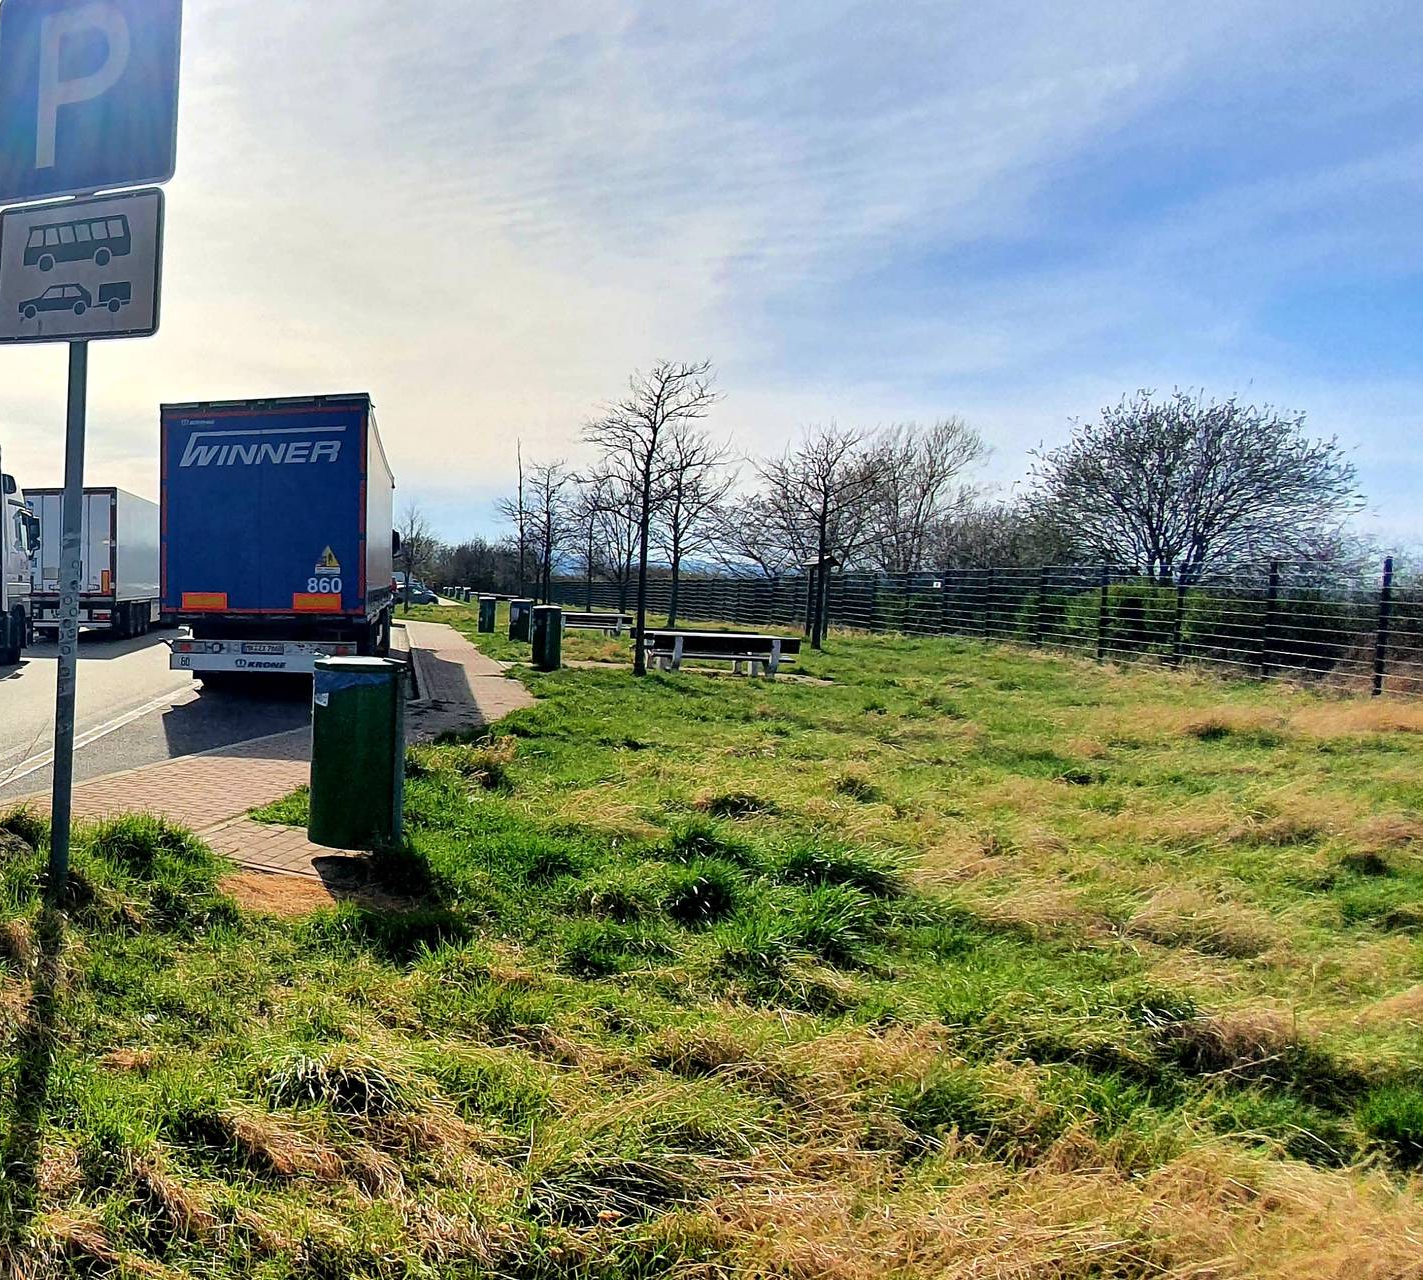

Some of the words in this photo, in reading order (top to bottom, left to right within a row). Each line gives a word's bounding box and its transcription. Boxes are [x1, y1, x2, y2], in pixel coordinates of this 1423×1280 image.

[36, 3, 129, 169] P
[179, 430, 345, 467] WINNER
[307, 577, 343, 593] 860
[180, 656, 190, 667] 60
[247, 661, 286, 669] KRONE
